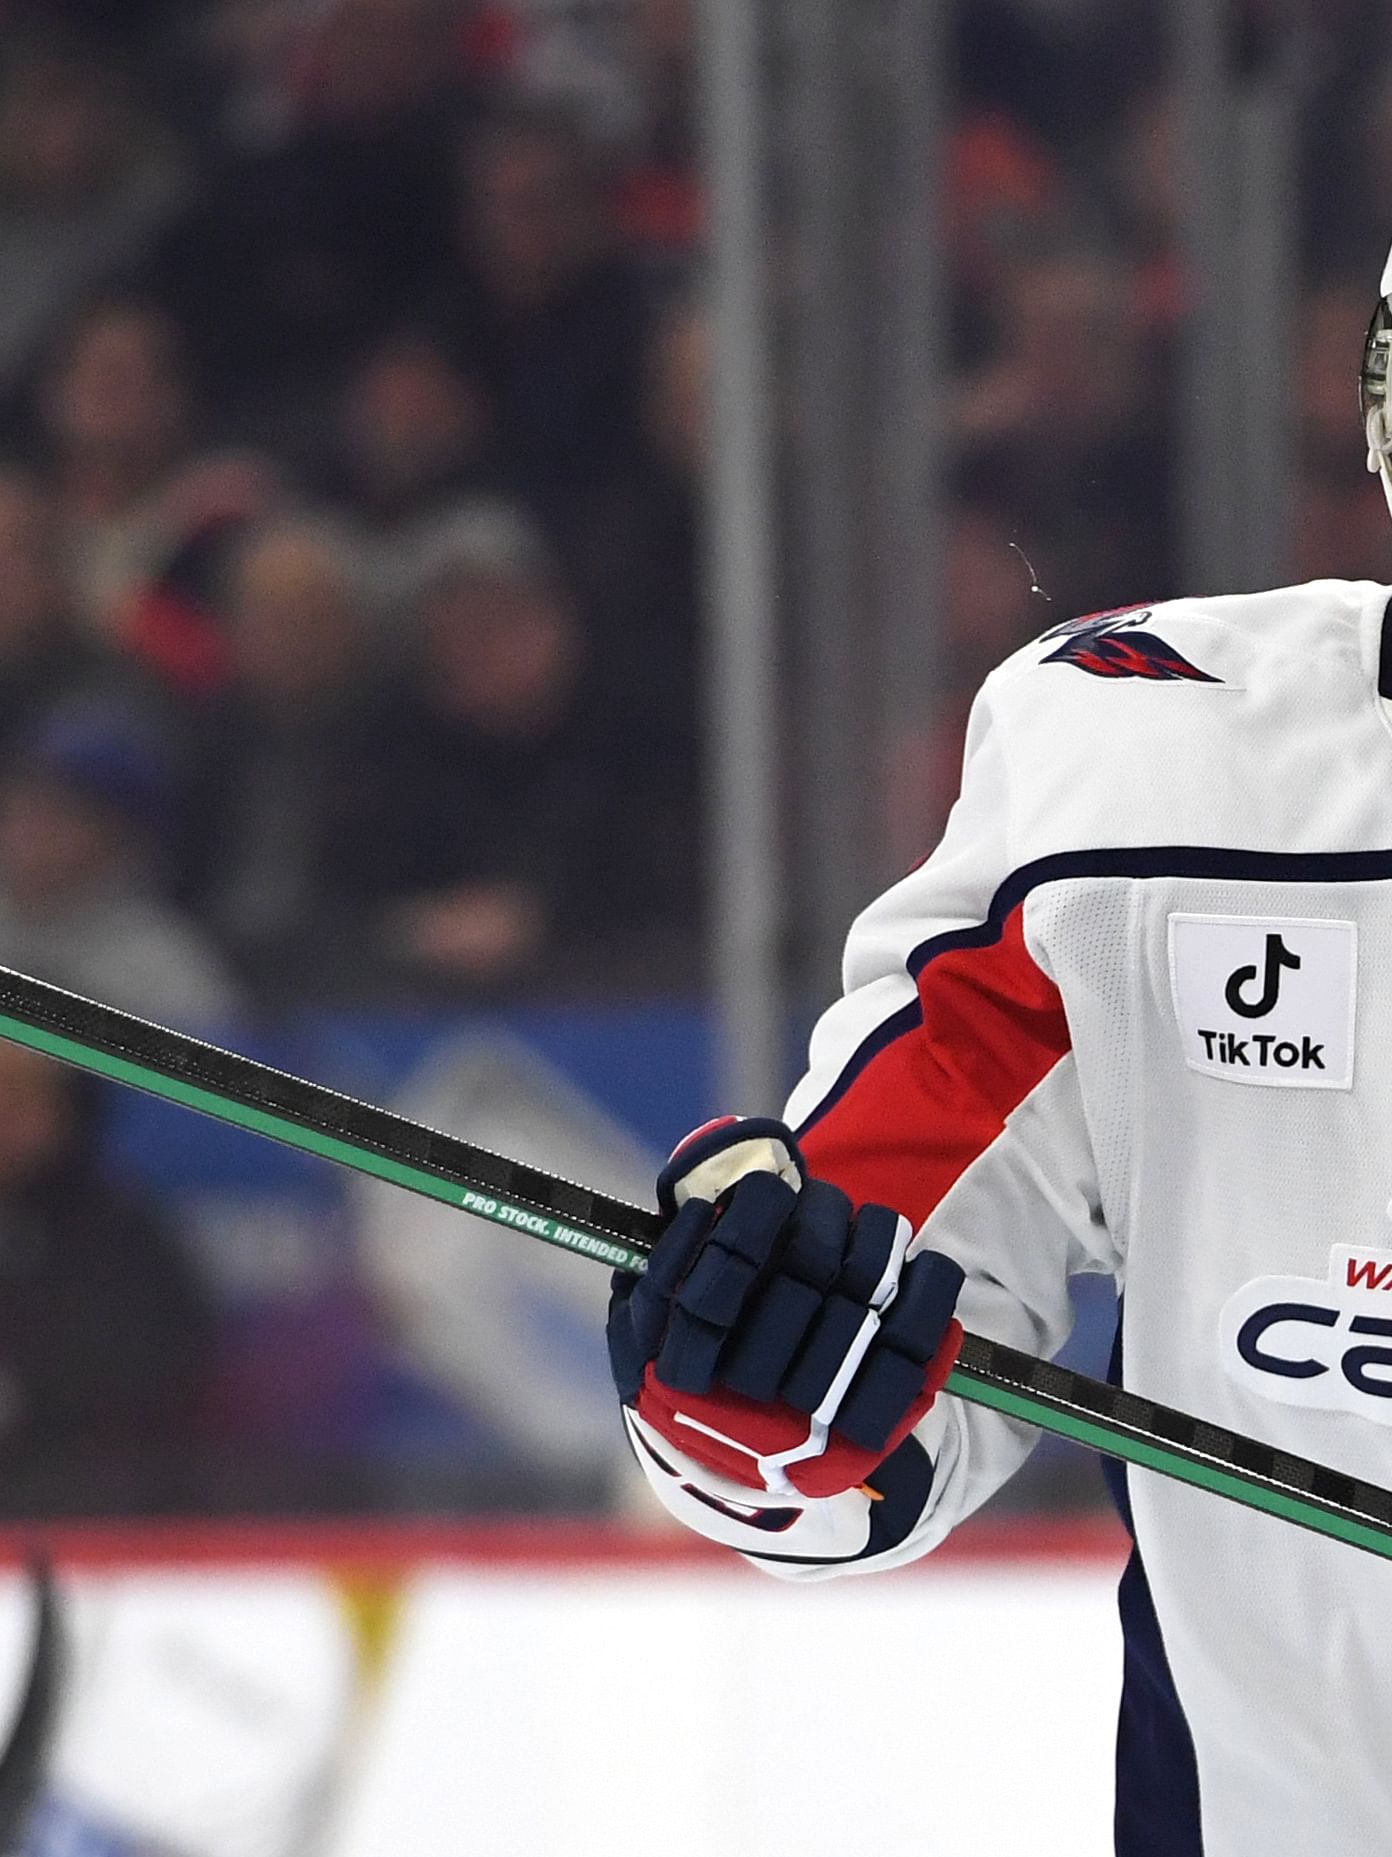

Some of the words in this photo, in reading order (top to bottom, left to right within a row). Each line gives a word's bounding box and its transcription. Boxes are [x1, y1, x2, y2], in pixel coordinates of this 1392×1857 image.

[1197, 1029, 1326, 1070] TikTok
[461, 1192, 498, 1214] PRO
[498, 1205, 550, 1235] STOCK.
[553, 1225, 629, 1264] INTENDED
